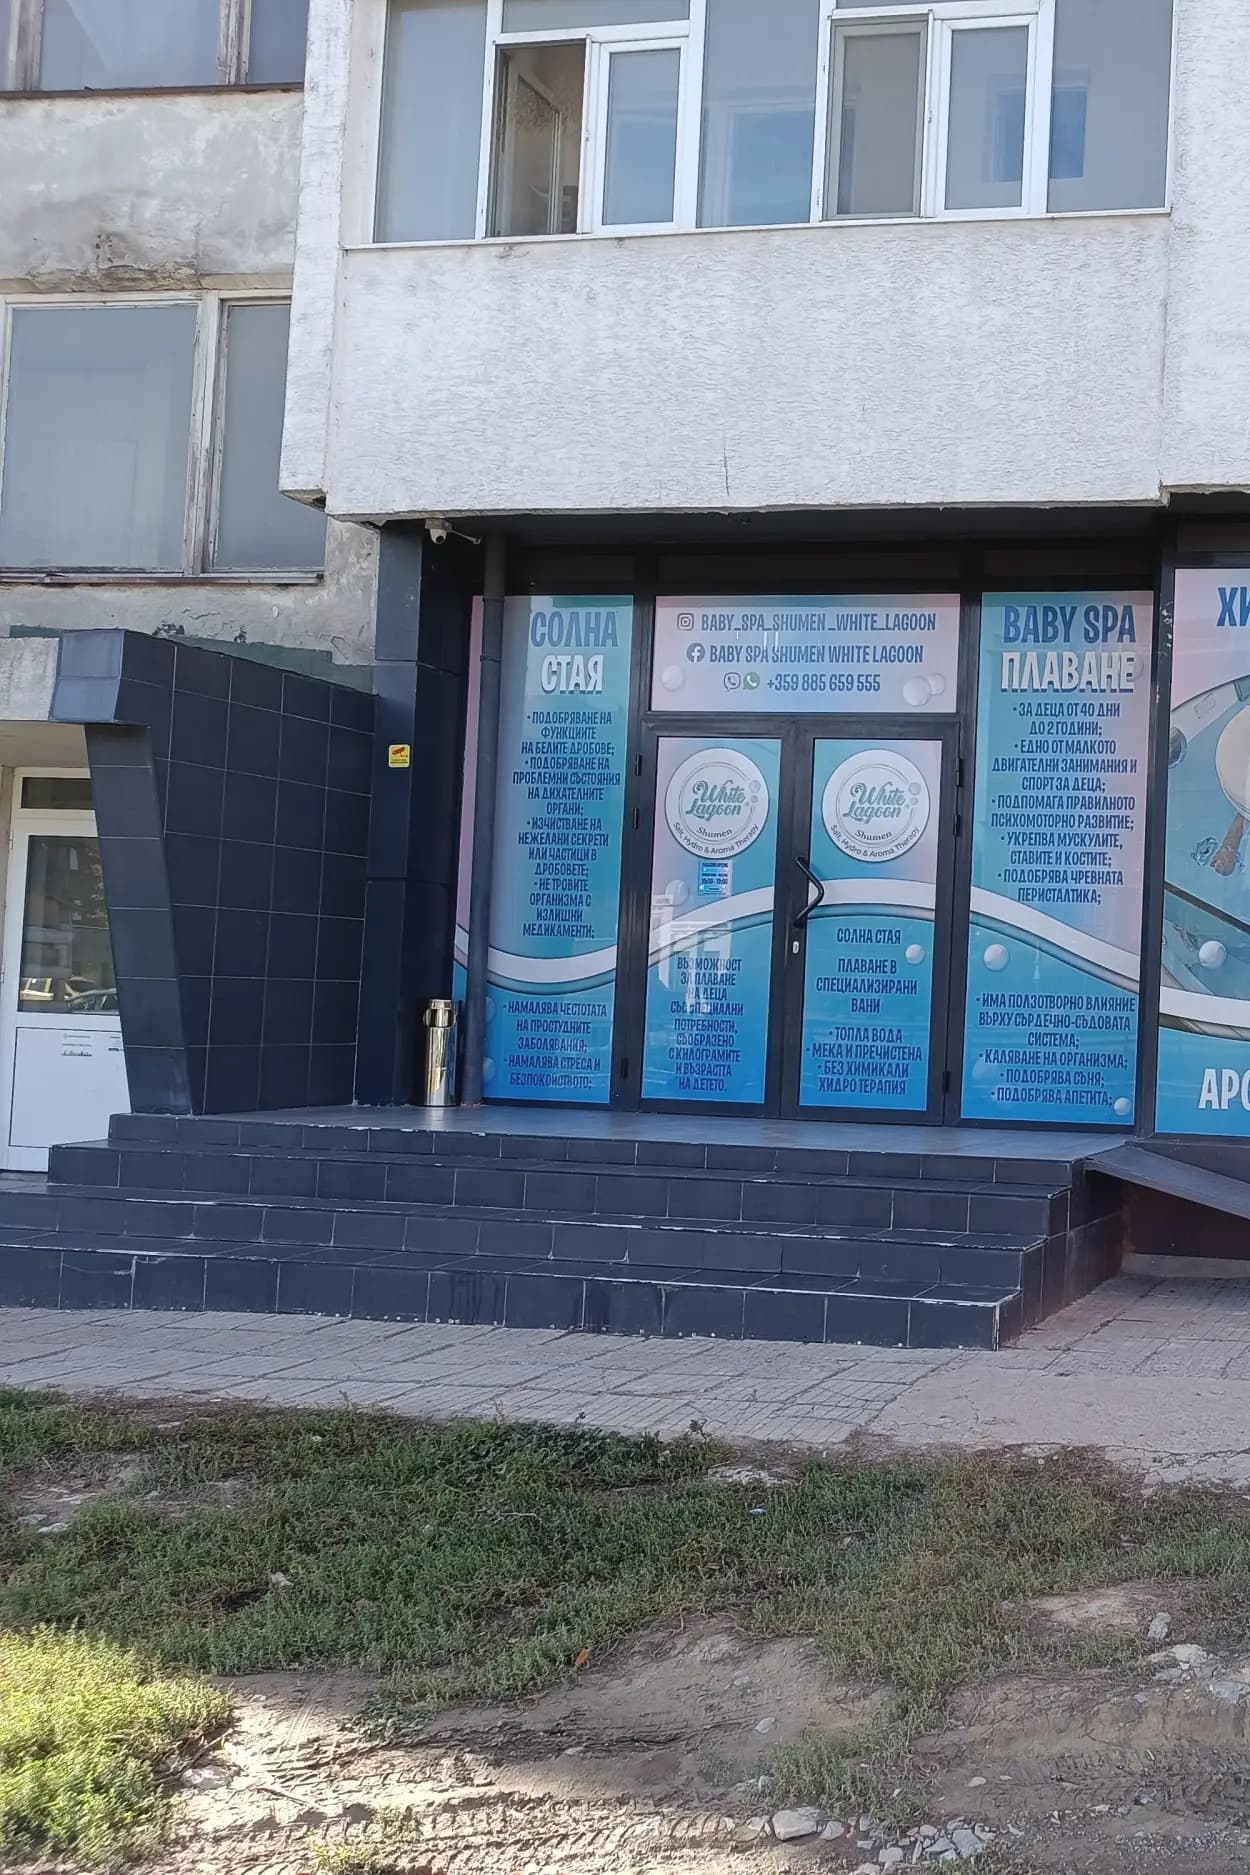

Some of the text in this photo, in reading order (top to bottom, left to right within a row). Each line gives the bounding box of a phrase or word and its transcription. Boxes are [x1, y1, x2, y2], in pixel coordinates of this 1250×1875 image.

[531, 612, 618, 647] СОЛНА
[1004, 606, 1136, 643] BABY SPA
[710, 645, 923, 663] BABY SPA SHUMEN WHITE LAGOON
[541, 654, 604, 693] СТАЯ
[1001, 651, 1136, 692] ПЛАВАНЕ
[768, 674, 880, 691] +359 885 659 555
[533, 712, 612, 724] ПОДОБРЯВАНЕ НА
[1019, 703, 1120, 718] ЗА ДЕЦА ОТ 40 ДНИ
[541, 727, 596, 739] ФУНКЦИИТЕ
[1029, 722, 1102, 737] ДО 2 ГОДИНИ;
[522, 742, 615, 756] НА БЕЛИТЕ ДРОБОВЕ;
[1021, 740, 1116, 753] ЕДНО ОТ МАЛКОТО
[530, 757, 609, 770] ПОДОБРЯВАНЕ НА
[992, 759, 1136, 772] ДВИГАТЕЛНИ ЗАНИМАНИЯ И
[513, 772, 620, 785] ПРОБЛЕМНИ СЪСТОЯНИЯ
[1022, 777, 1105, 792] СПОРТ ЗА ДЕЦА;
[528, 787, 604, 800] НА ДИХАТЕЛНИТЕ
[692, 780, 745, 804] White
[850, 782, 905, 806] White
[547, 802, 583, 817] ОРГАНИ;
[686, 796, 742, 821] Lagoon
[998, 795, 1135, 810] ПОДПОМАГА ПРАВИЛНОТО
[842, 798, 901, 824] Lagoon
[532, 817, 602, 830] ИЗЧИСТВАНЕ НА
[991, 813, 1134, 830] ПСИХОМОТОРНО РАЗВИТИЕ;
[518, 833, 608, 846] НЕЖЕЛАНИ СЕКРЕТИ
[697, 827, 732, 838] Shumen
[711, 824, 759, 853] Aroma Therapy
[855, 830, 892, 840] Shumen
[1007, 832, 1123, 848] УКРЕПВА МУСКУЛИТЕ,
[869, 827, 920, 857] Aroma Therapy
[529, 847, 597, 862] ИЛИ ЧАСТИЦИ В
[1010, 851, 1112, 867] СТАВИТЕ И КОСТИТЕ;
[535, 863, 589, 877] ДРОБОВЕТЕ;
[540, 879, 589, 891] НЕ ТРОВИТЕ
[1004, 871, 1123, 885] ПОДОБРЯВА ЧРЕВНАТА
[530, 894, 591, 906] ОРГАНИЗМА С
[1018, 889, 1101, 905] ПЕРИСТАЛТИКА;
[537, 909, 582, 922] ИЗЛИШНИ
[523, 924, 595, 938] МЕДИКАМЕНТИ;
[837, 928, 900, 944] СОЛНА СТАЯ
[838, 958, 896, 974] ПЛАВАНЕ В
[681, 971, 736, 985] ЗА ПЛАВАНЕ
[816, 978, 917, 995] СПЕЦИАЛИЗИРАНИ
[703, 988, 727, 1001] ДЕЦА
[508, 1003, 606, 1016] НАМАЛЯВА ЧЕСТОТАТА
[671, 1001, 687, 1013] СЪС
[851, 998, 880, 1013] ВАНИ
[982, 994, 1135, 1011] ИМА ПОЛЗОТВОРНО ВЛИЯНИЕ
[517, 1019, 591, 1033] НА ПРОСТУДНИТЕ
[674, 1019, 737, 1034] ПОТРЕБНОСТИ,
[979, 1013, 1131, 1030] ВЪРХУ СЪРДЕЧНО-СЪДОВАТА
[676, 1034, 734, 1046] СЪОБРАЗЕНО
[835, 1027, 902, 1043] ТОПЛА ВОДА
[1028, 1033, 1080, 1048] СИСТЕМА;
[676, 1048, 741, 1062] КИЛОГРАМИТЕ
[812, 1043, 922, 1061] МЕКА И ПРЕЧИСТЕНА
[985, 1050, 1127, 1069] КАЛЯВАНЕ НА ОРГАНИЗМА;
[509, 1056, 593, 1070] НАМАЛЯВА СТРЕСА
[824, 1060, 909, 1077] БЕЗ ХИМИКАЛИ
[693, 1078, 727, 1092] ДЕТЕТО.
[1006, 1069, 1104, 1087] ПОДОБРЯВА СЪНЯ;
[819, 1077, 905, 1095] ХИДРО ТЕРАПИЯ
[997, 1088, 1113, 1106] ПОДОБРЯВА АПЕТИТА;
